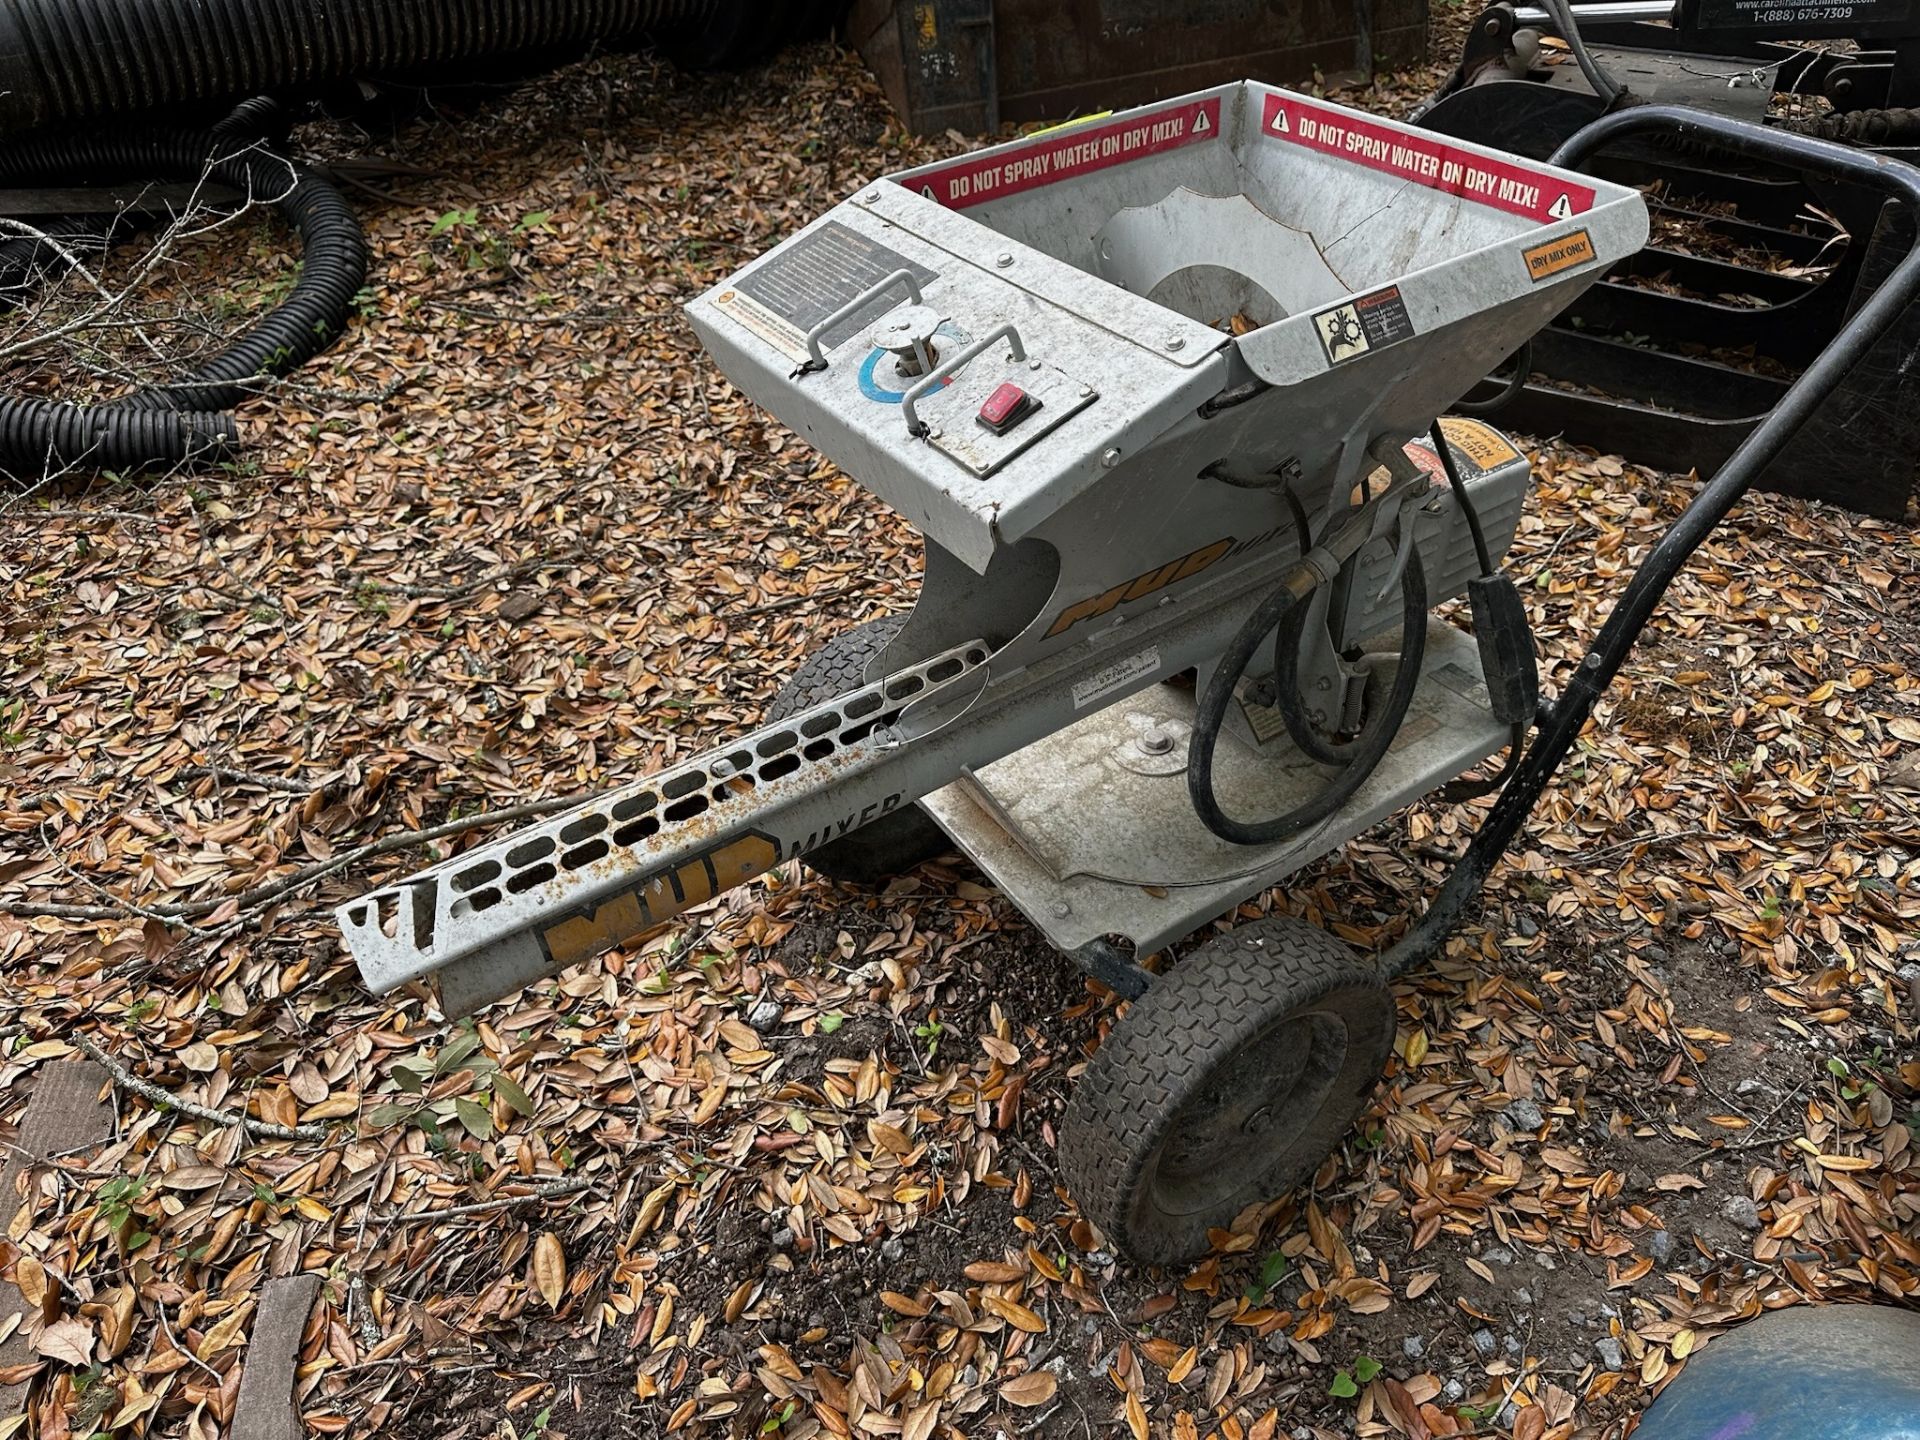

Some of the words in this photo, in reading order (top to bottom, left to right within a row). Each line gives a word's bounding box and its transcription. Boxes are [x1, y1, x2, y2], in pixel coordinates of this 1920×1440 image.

[1753, 9, 1795, 23] 1-(888)
[1797, 6, 1853, 21] 676-7309
[949, 179, 970, 200] DO
[973, 167, 1001, 193] NOT
[1004, 154, 1050, 184] SPRAY
[1053, 139, 1100, 170] WATER
[1101, 135, 1121, 157] ON
[1122, 127, 1149, 152] DRY
[1151, 117, 1184, 143] MIX!
[1299, 117, 1318, 138] DO
[1318, 122, 1346, 147] NOT
[1345, 132, 1390, 162] SPRAY
[1390, 140, 1439, 178] WATER
[1441, 161, 1463, 185] ON
[1465, 167, 1499, 195] DRY
[1498, 177, 1540, 209] MIX!
[1531, 254, 1548, 269] DRY
[1549, 251, 1566, 262] MIX
[1566, 241, 1587, 256] ONLY
[1460, 440, 1485, 460] THIS
[1471, 440, 1494, 457] NOT
[1039, 536, 1238, 642] MUD
